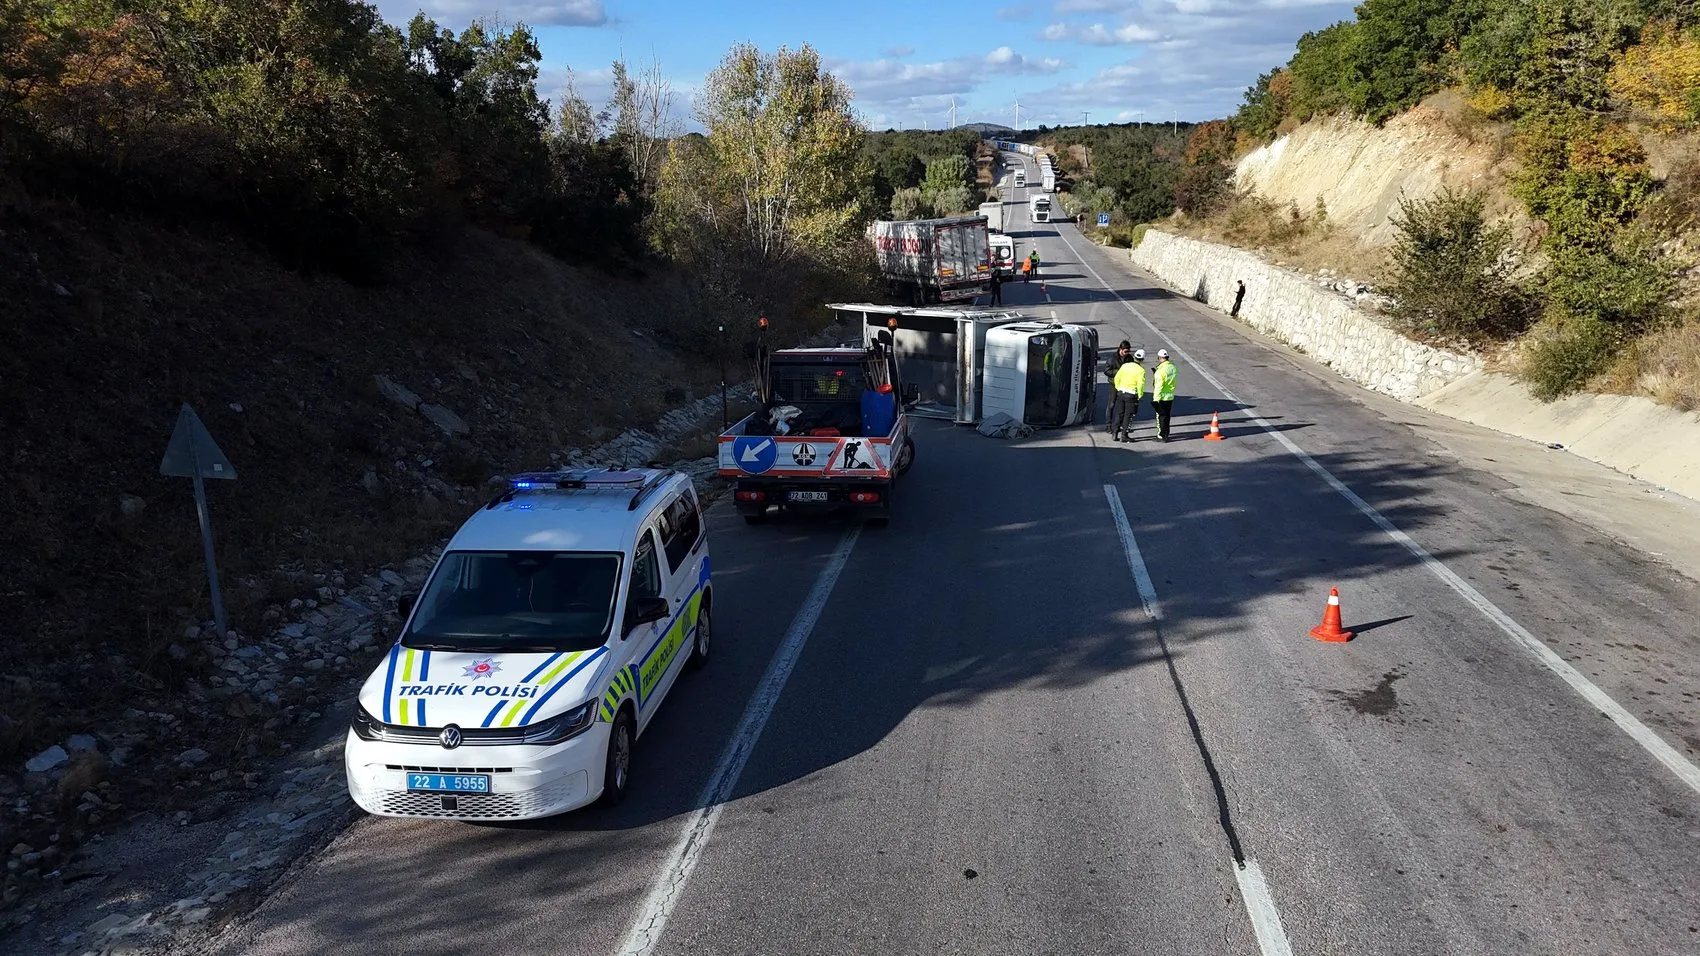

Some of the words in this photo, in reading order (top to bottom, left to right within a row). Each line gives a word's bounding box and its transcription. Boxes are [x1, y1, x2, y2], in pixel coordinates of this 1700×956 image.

[642, 657, 660, 691] TRAFİK
[660, 633, 675, 663] POLİSİ
[399, 682, 468, 696] TRAFİK
[471, 684, 539, 698] POLİSİ
[414, 775, 430, 788] 22
[440, 776, 447, 789] A
[454, 777, 486, 790] 5955
